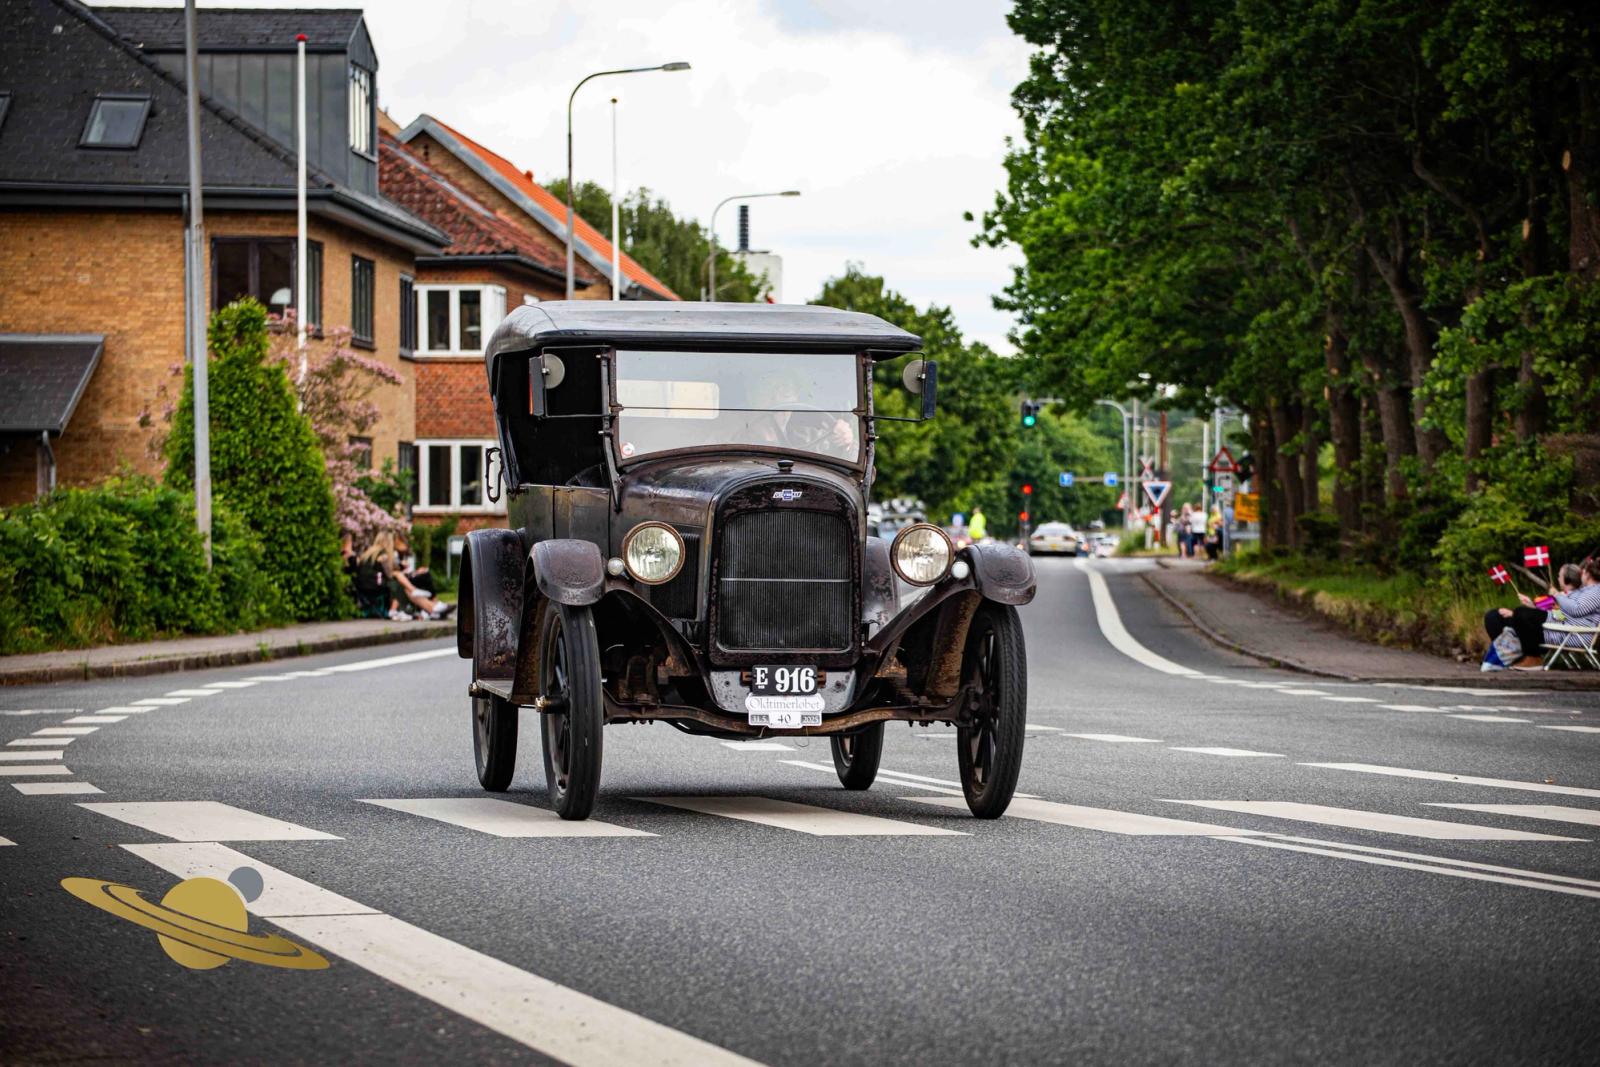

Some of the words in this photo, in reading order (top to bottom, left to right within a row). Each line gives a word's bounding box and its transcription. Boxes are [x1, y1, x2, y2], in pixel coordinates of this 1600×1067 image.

[755, 667, 768, 685] E
[775, 667, 815, 693] 916
[778, 714, 791, 724] 40
